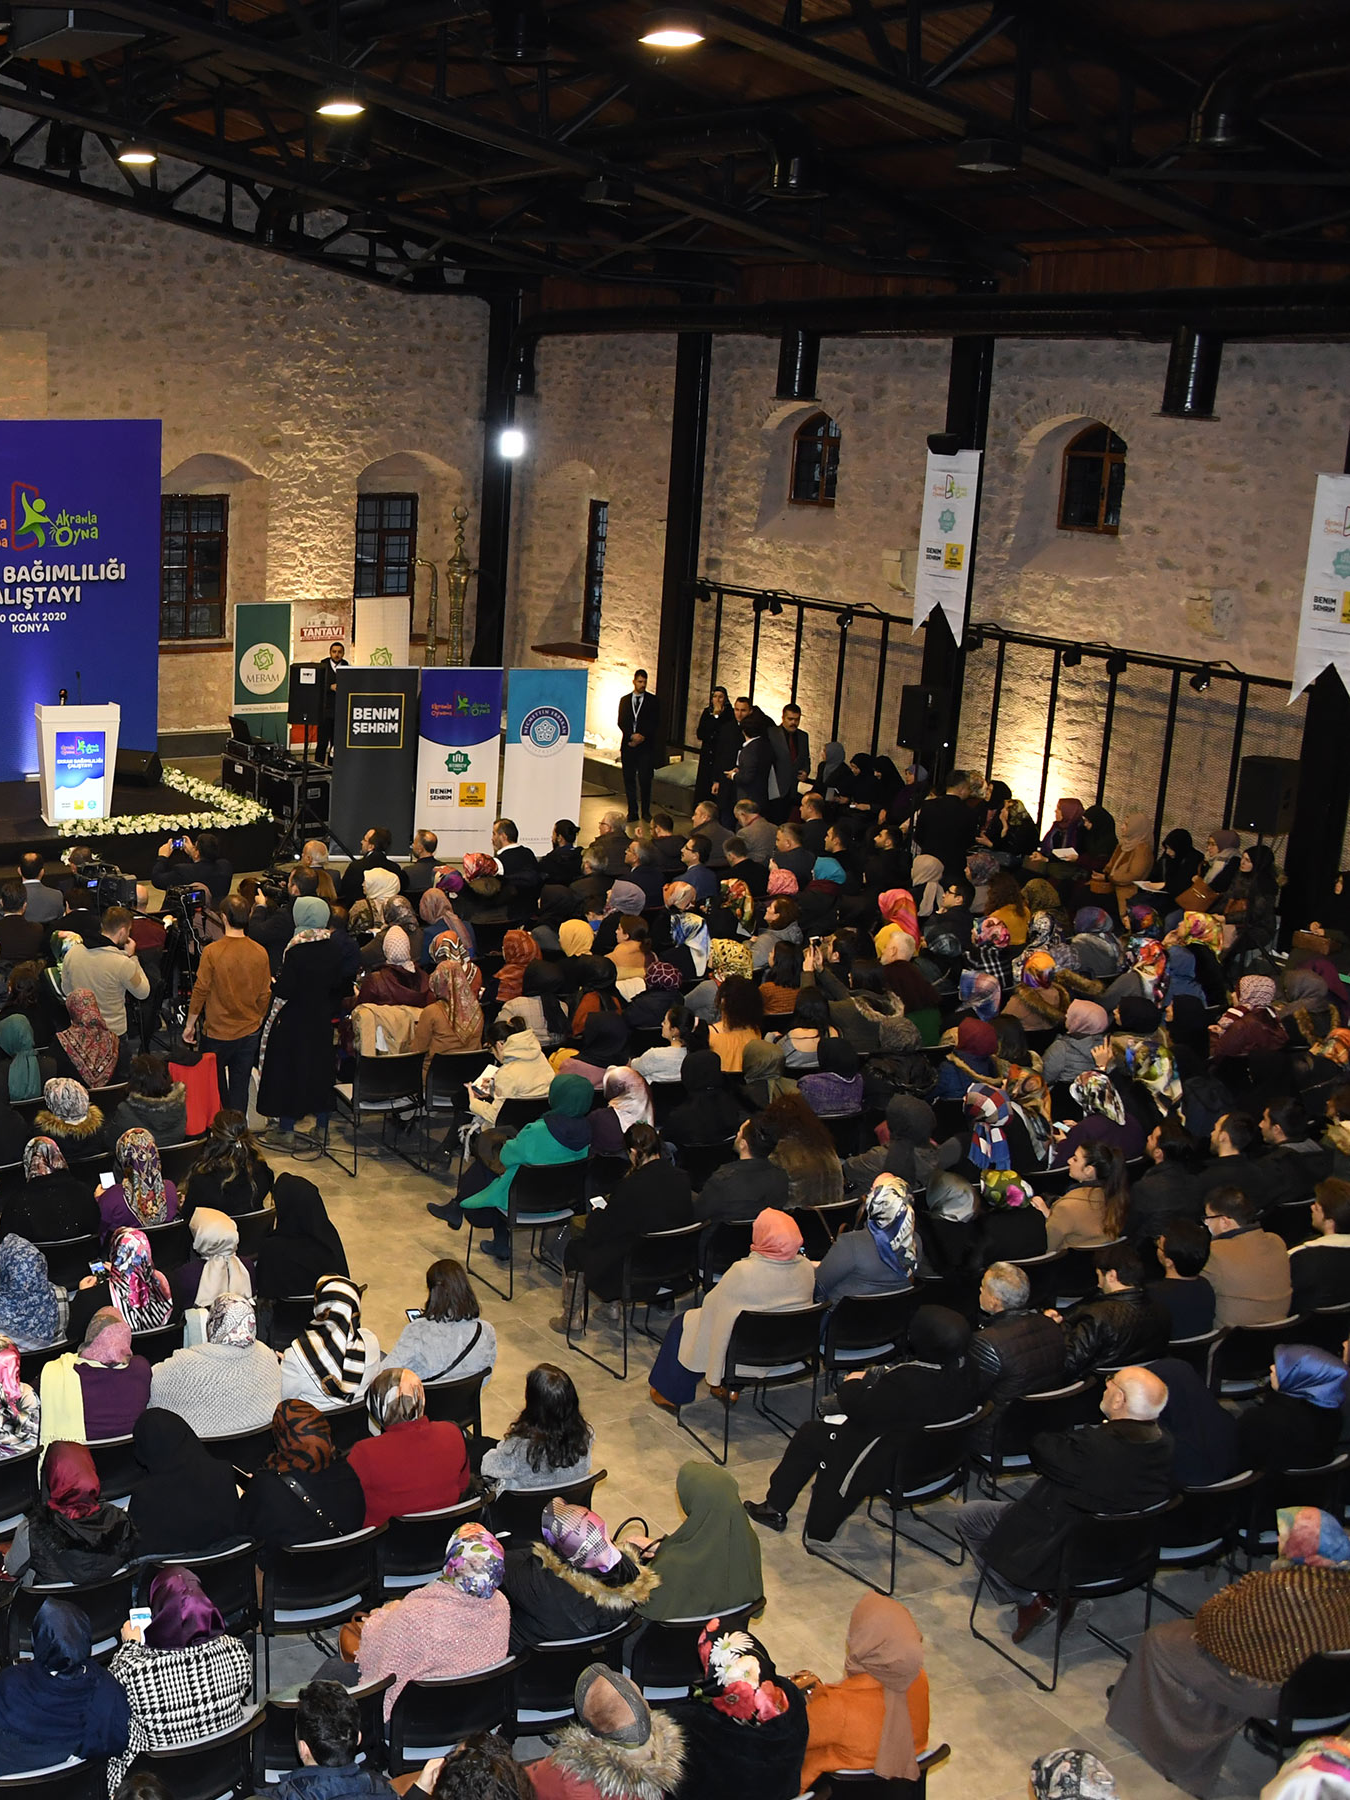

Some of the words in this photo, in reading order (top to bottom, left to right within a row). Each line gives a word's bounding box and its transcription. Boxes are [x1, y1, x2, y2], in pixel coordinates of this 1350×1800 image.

[56, 509, 97, 527] Akranla
[55, 526, 98, 547] Oyna
[3, 558, 126, 583] BAĞIMLILIĞI
[9, 613, 40, 623] OCAK
[42, 612, 67, 621] 2020
[12, 623, 50, 633] KONYA
[246, 673, 280, 683] MERAM
